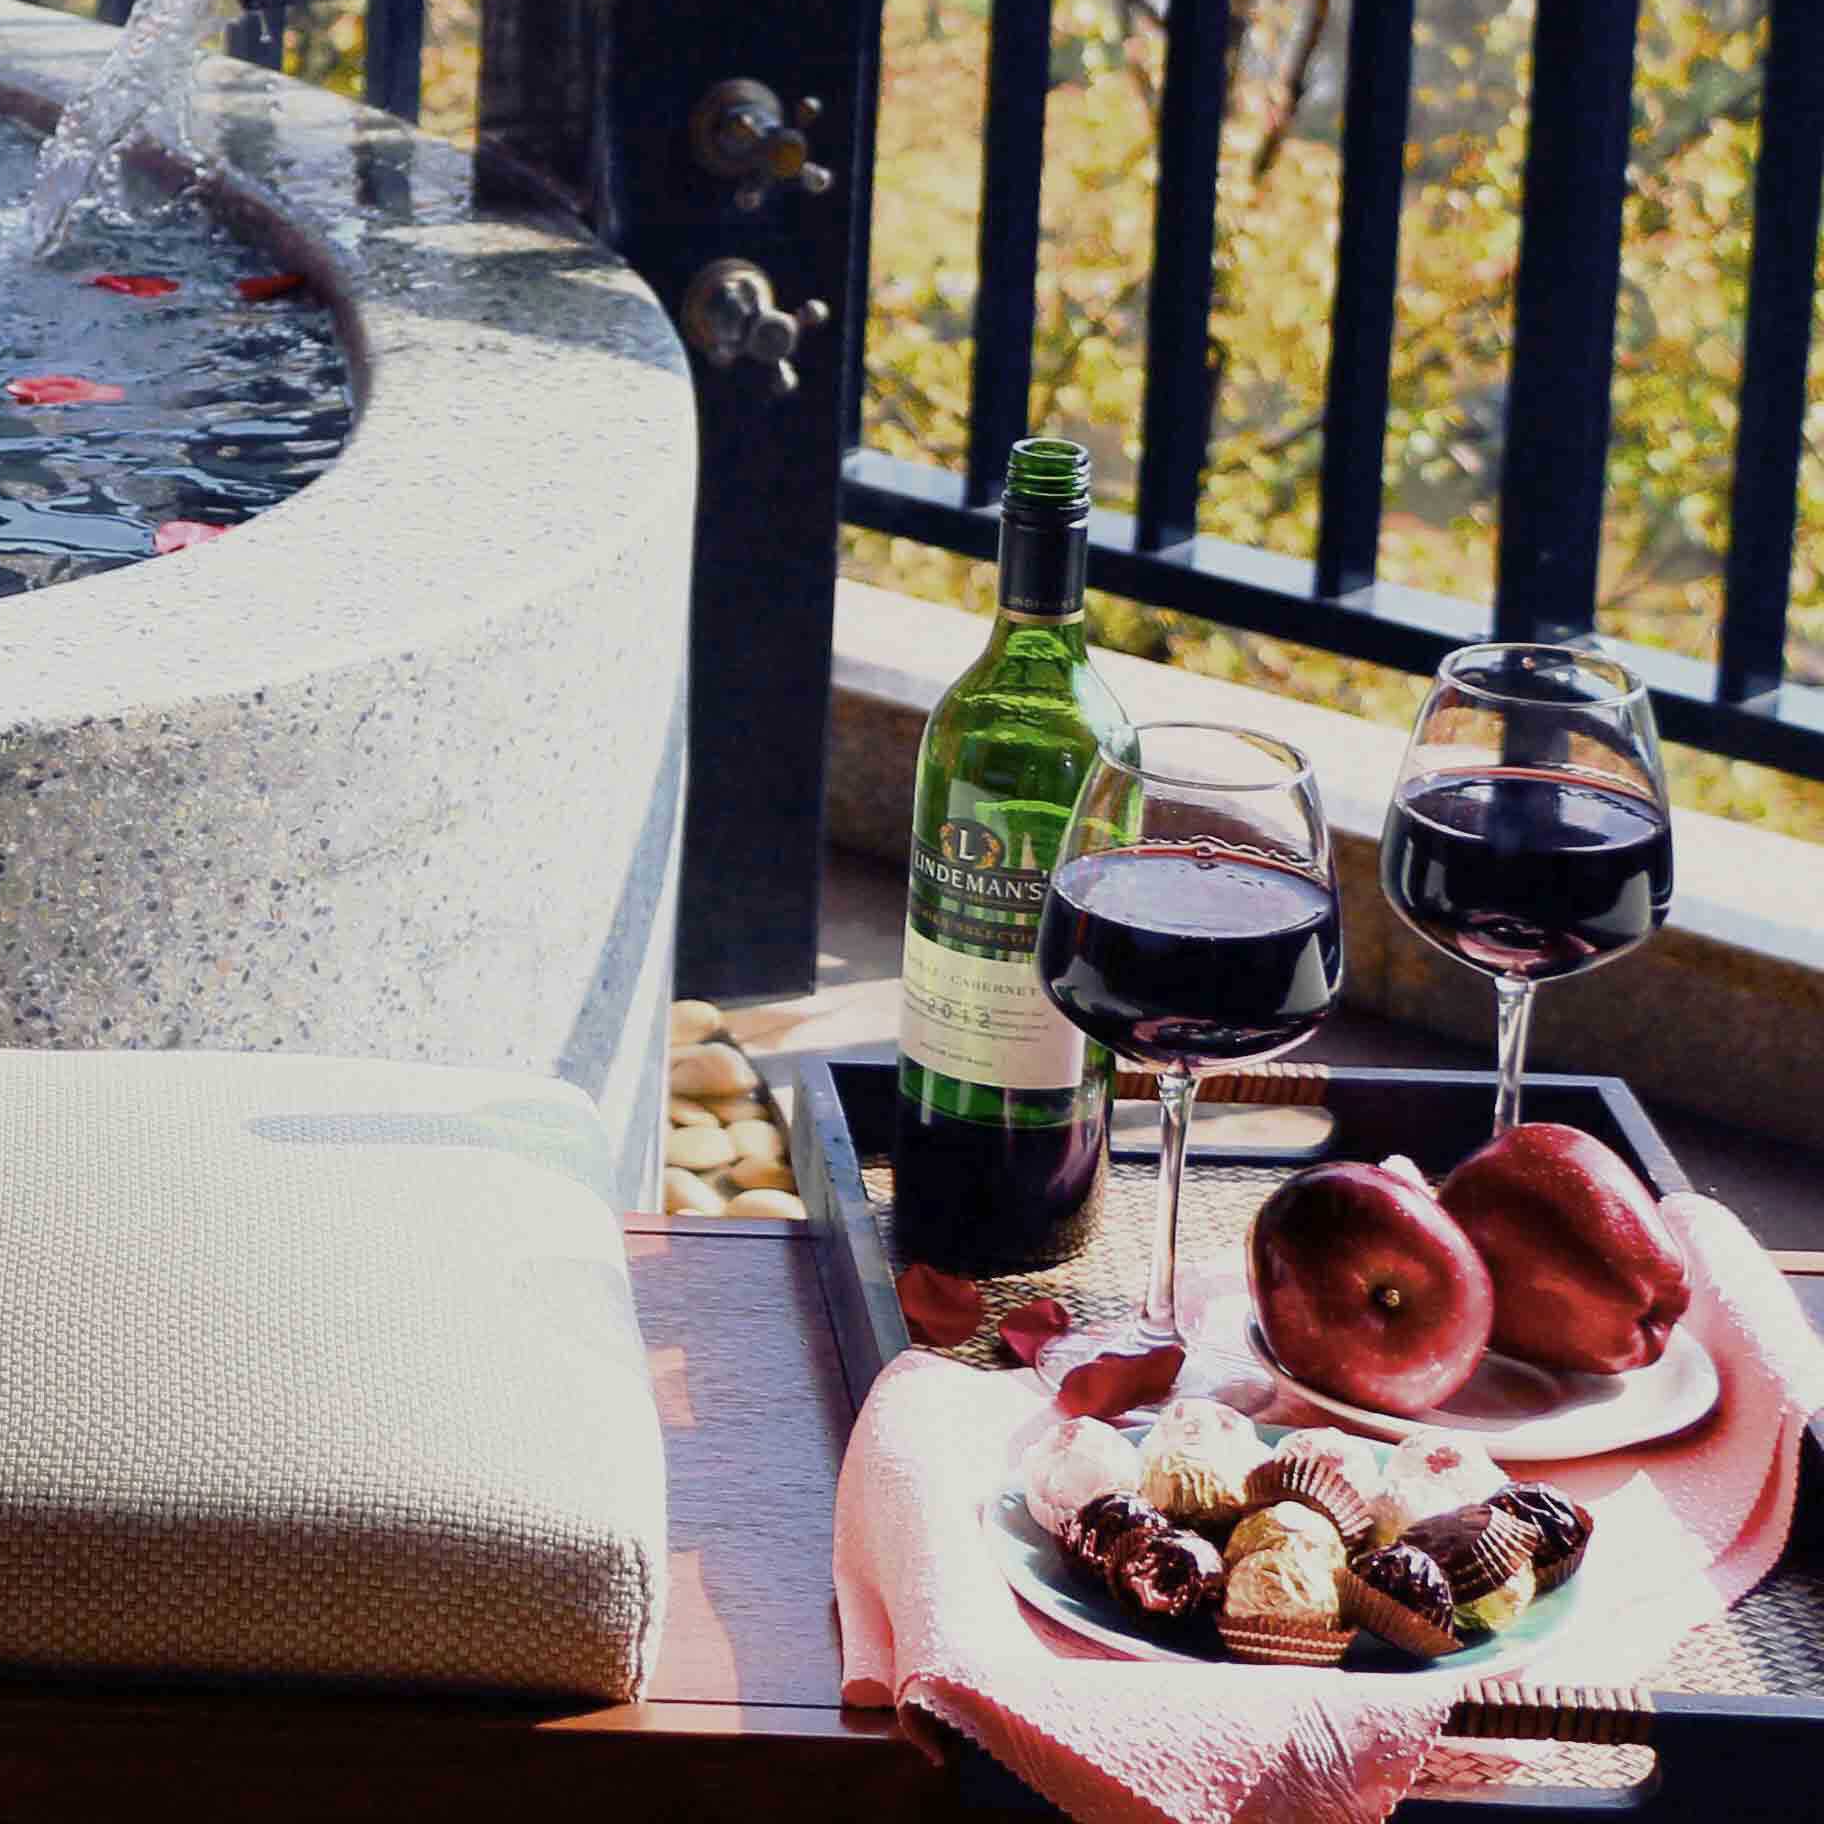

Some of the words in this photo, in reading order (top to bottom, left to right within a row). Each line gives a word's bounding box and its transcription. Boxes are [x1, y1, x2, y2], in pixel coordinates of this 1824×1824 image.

[959, 829, 976, 860] L
[914, 849, 1042, 900] LINDEMAN'S
[950, 975, 1038, 997] CABERNET
